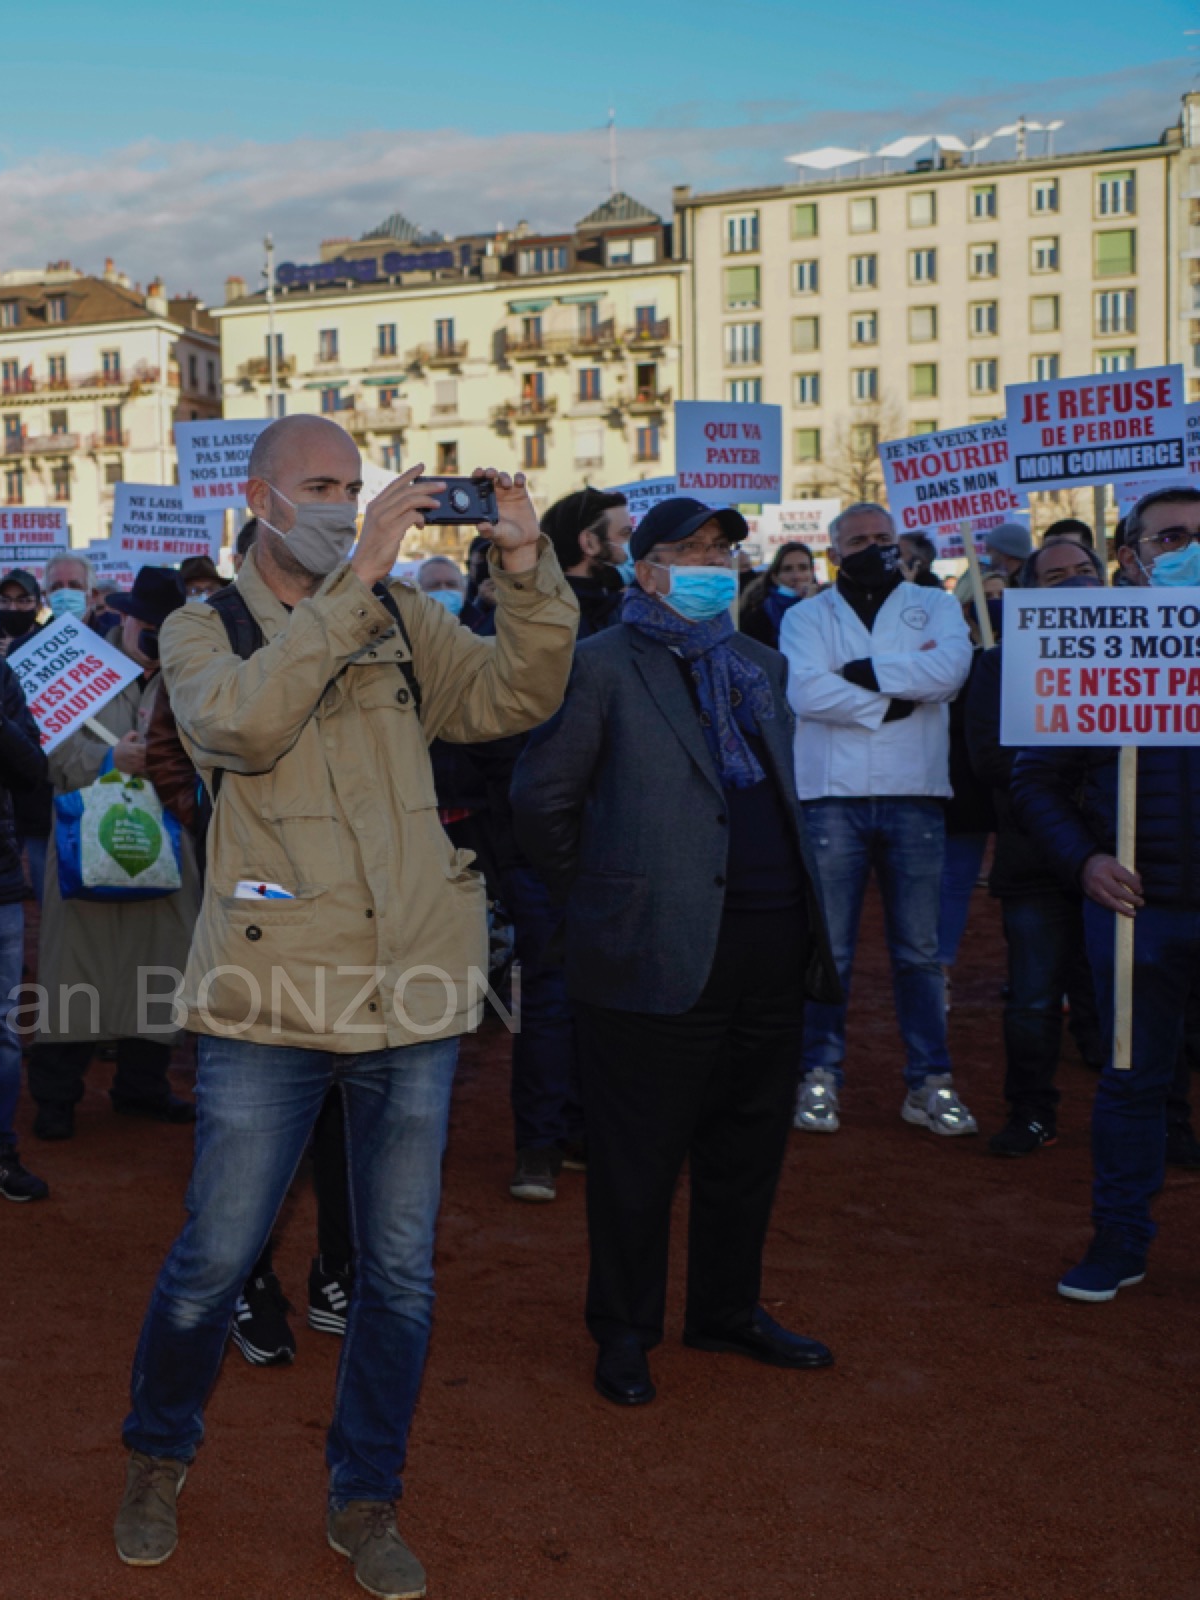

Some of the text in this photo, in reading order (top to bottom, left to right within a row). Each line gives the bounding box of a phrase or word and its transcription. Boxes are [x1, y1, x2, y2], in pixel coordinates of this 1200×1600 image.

[1021, 378, 1173, 424] JE REFUSE
[192, 436, 210, 448] NE
[704, 422, 762, 442] QUI VA
[886, 444, 904, 460] JE
[906, 439, 930, 454] NE
[932, 429, 978, 449] VEUX
[1041, 416, 1155, 447] DE PERDRE
[196, 452, 221, 464] PAS
[706, 447, 761, 464] PAYER
[892, 440, 1009, 484] MOURIR
[1020, 443, 1181, 479] MON COMMERCE
[191, 468, 218, 480] NOS
[916, 470, 999, 502] DANS MON
[12, 513, 61, 529] REFUSE
[158, 512, 205, 524] MOURIR
[902, 487, 1020, 528] COMMERCE
[1018, 605, 1149, 630] FERMER
[32, 624, 79, 660] TOUS
[1039, 635, 1096, 659] LES
[1104, 635, 1123, 659] 3
[24, 646, 86, 694] 3 MOIS,
[68, 654, 104, 684] PAS
[1035, 667, 1072, 698] CE
[1079, 667, 1160, 698] N'EST
[44, 667, 122, 733] SOLUTION
[1035, 703, 1070, 733] LA
